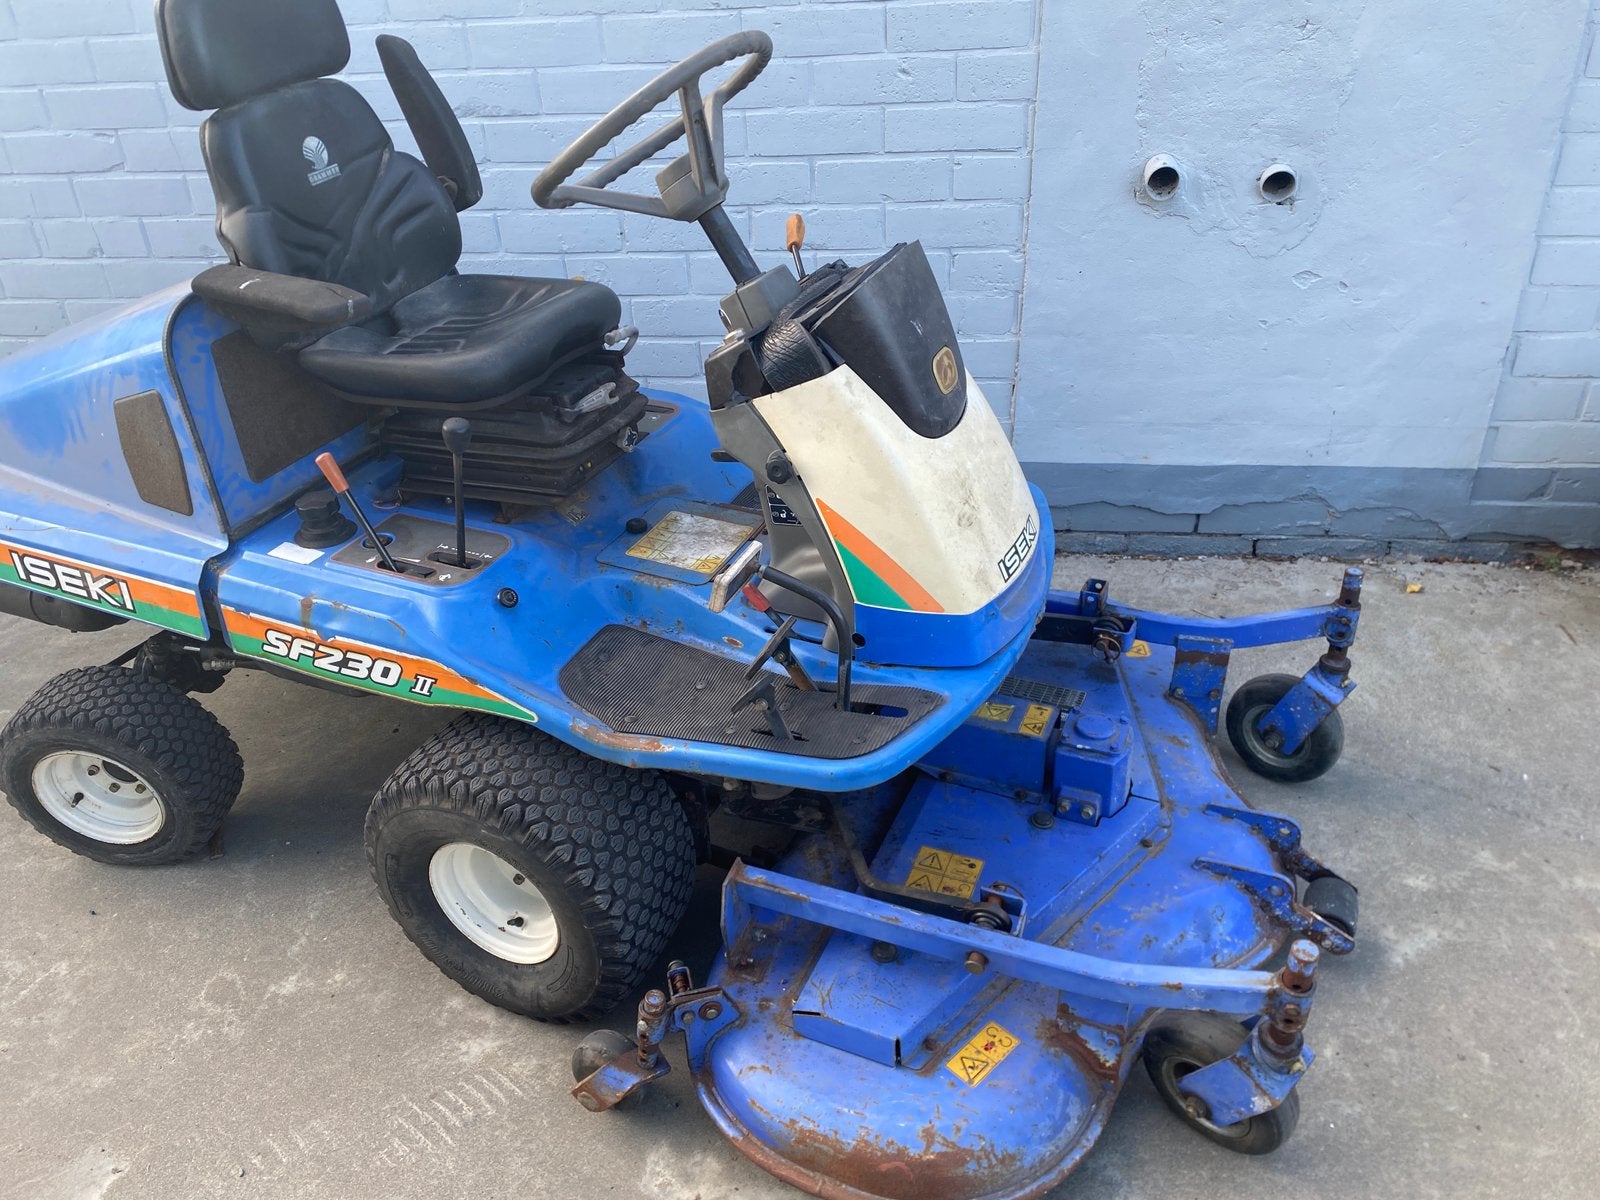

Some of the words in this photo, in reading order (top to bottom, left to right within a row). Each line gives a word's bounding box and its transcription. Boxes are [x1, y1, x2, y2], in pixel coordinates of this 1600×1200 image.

[9, 549, 136, 613] ISEKI
[998, 514, 1037, 583] ISEKI
[262, 629, 403, 688] SF230
[409, 674, 437, 698] II
